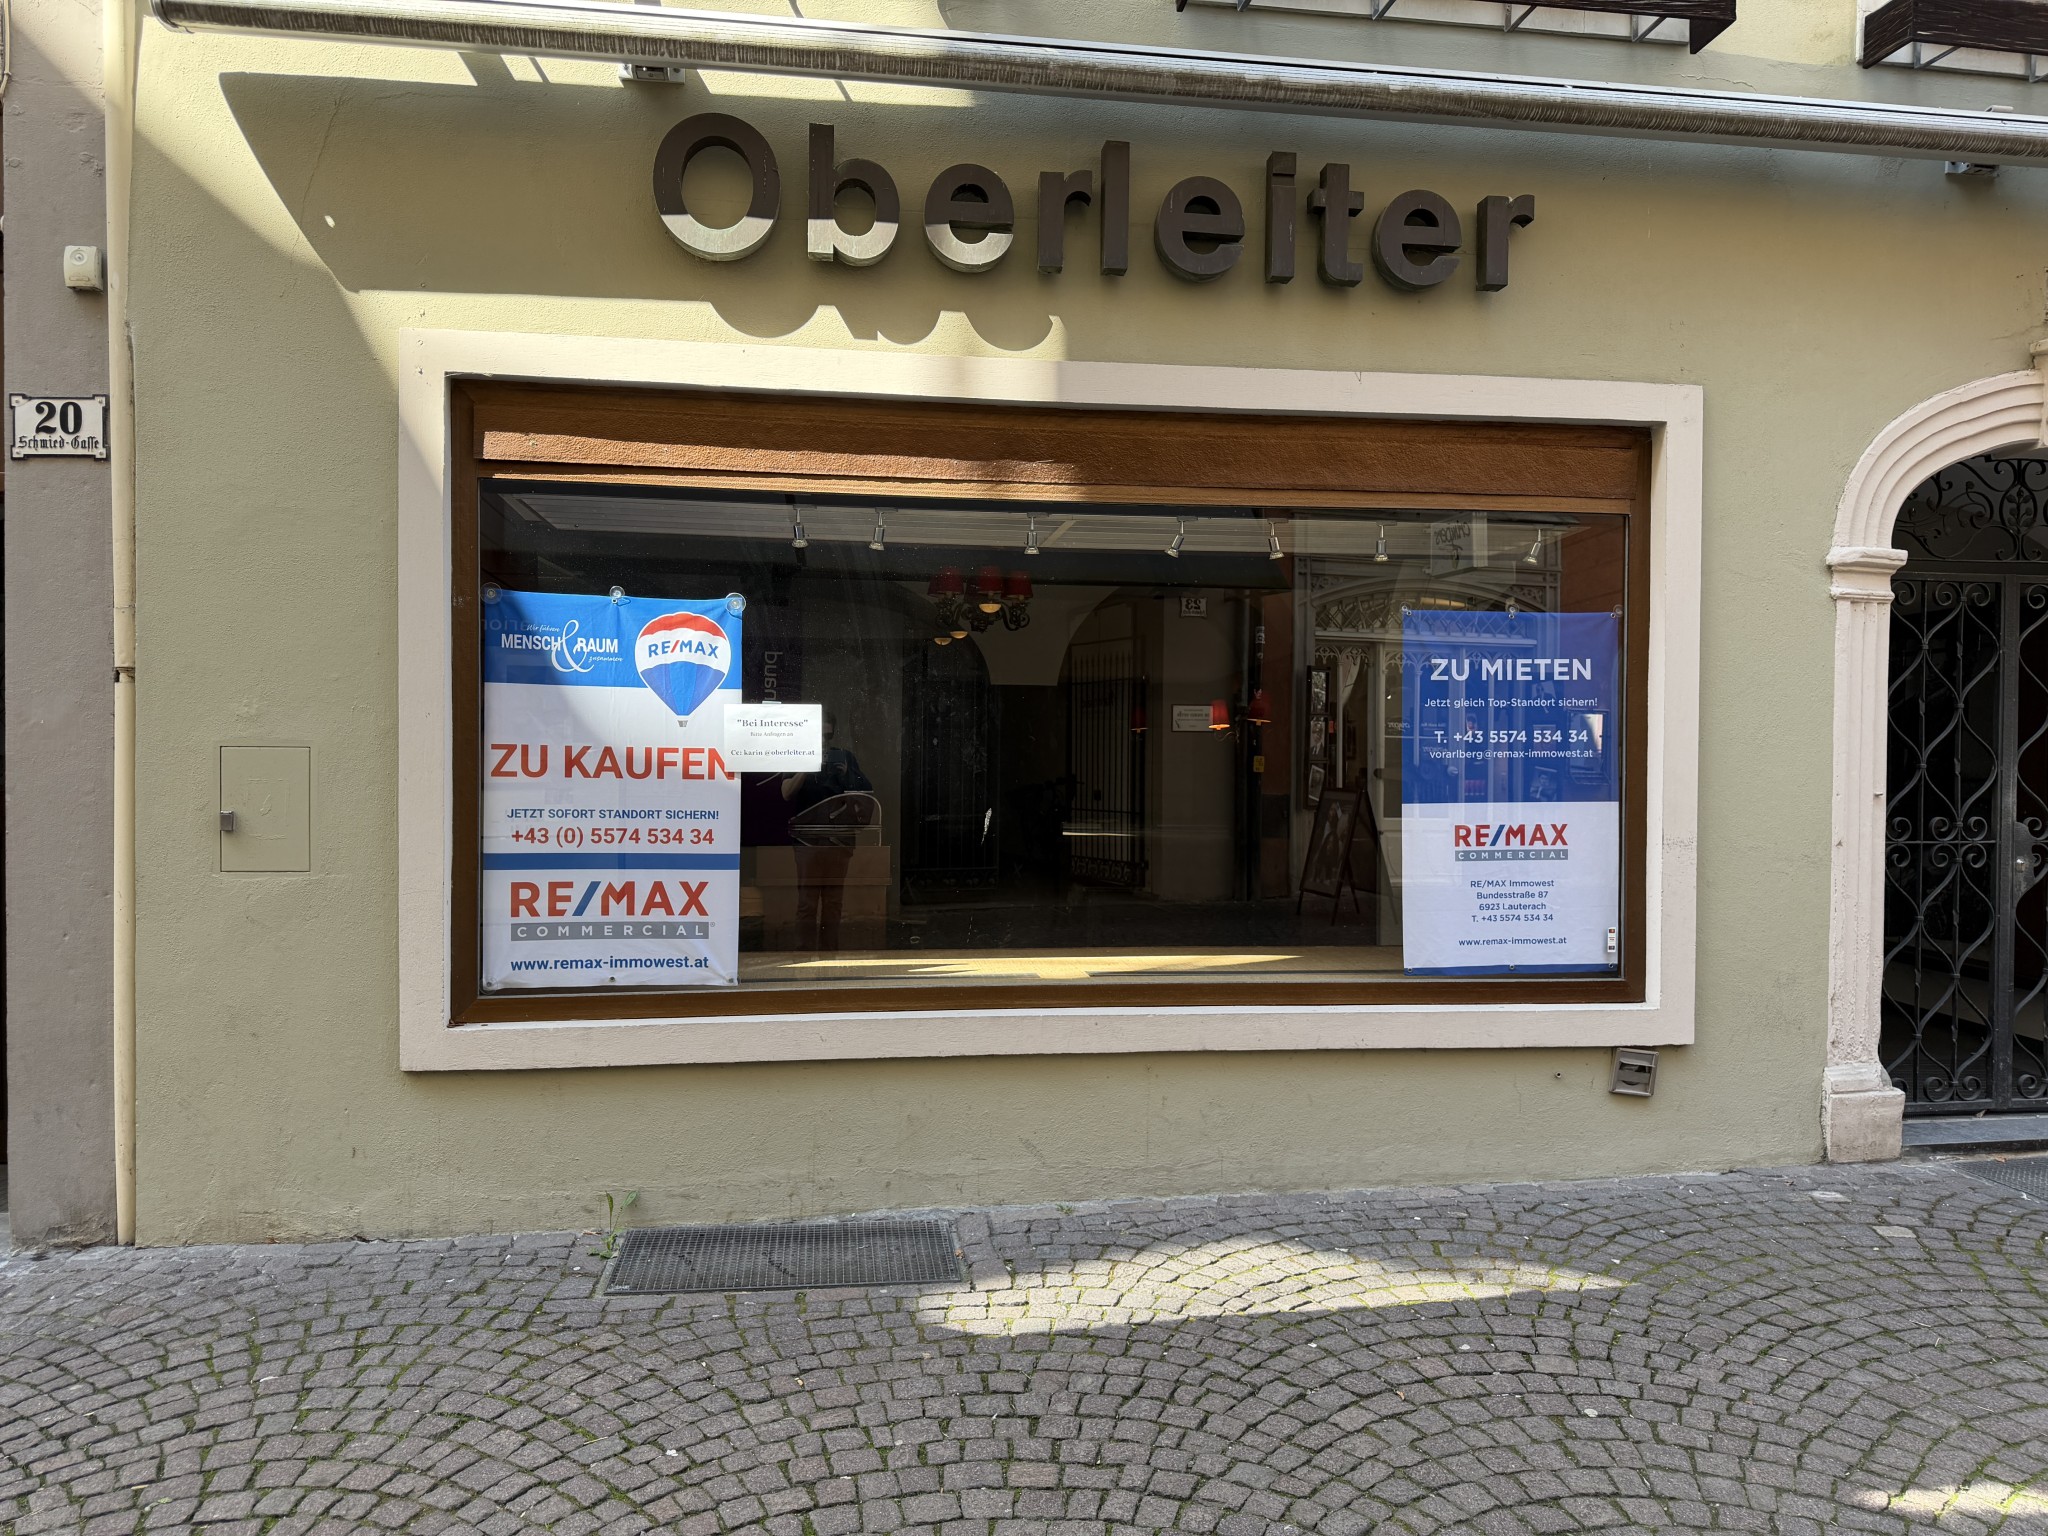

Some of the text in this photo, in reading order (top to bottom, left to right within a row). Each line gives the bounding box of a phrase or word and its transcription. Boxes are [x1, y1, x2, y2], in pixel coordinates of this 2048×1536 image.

[652, 112, 1536, 292] Oberleiter
[35, 401, 83, 435] 20
[501, 633, 561, 651] MENSCH
[577, 637, 618, 653] RAUM
[648, 639, 719, 659] RE/MAX
[1430, 658, 1591, 681] ZU MIETEN
[1424, 697, 1598, 709] Jetzt gleich Top-Standort sichern!
[1434, 731, 1589, 744] T. +43 5574 534 34
[490, 743, 735, 781] ZU KAUFEN
[1429, 749, 1593, 760] vorarlberg@remax-immowest.at
[507, 808, 719, 820] JETZT SOFORT STANDORT SICHERN!
[511, 826, 714, 848] +43 (0) 5574 534 34
[1455, 823, 1568, 847] RE/MAX
[1458, 851, 1566, 860] COMMERCIAL
[1470, 880, 1507, 888] RE/MAX
[510, 881, 709, 917] RE/MAX
[1479, 902, 1547, 911] 6923 Lauterach
[517, 925, 704, 938] COMMERCIAL
[1458, 937, 1567, 946] www.remax-immowest.at
[510, 956, 709, 971] www.remax-immowest.at
